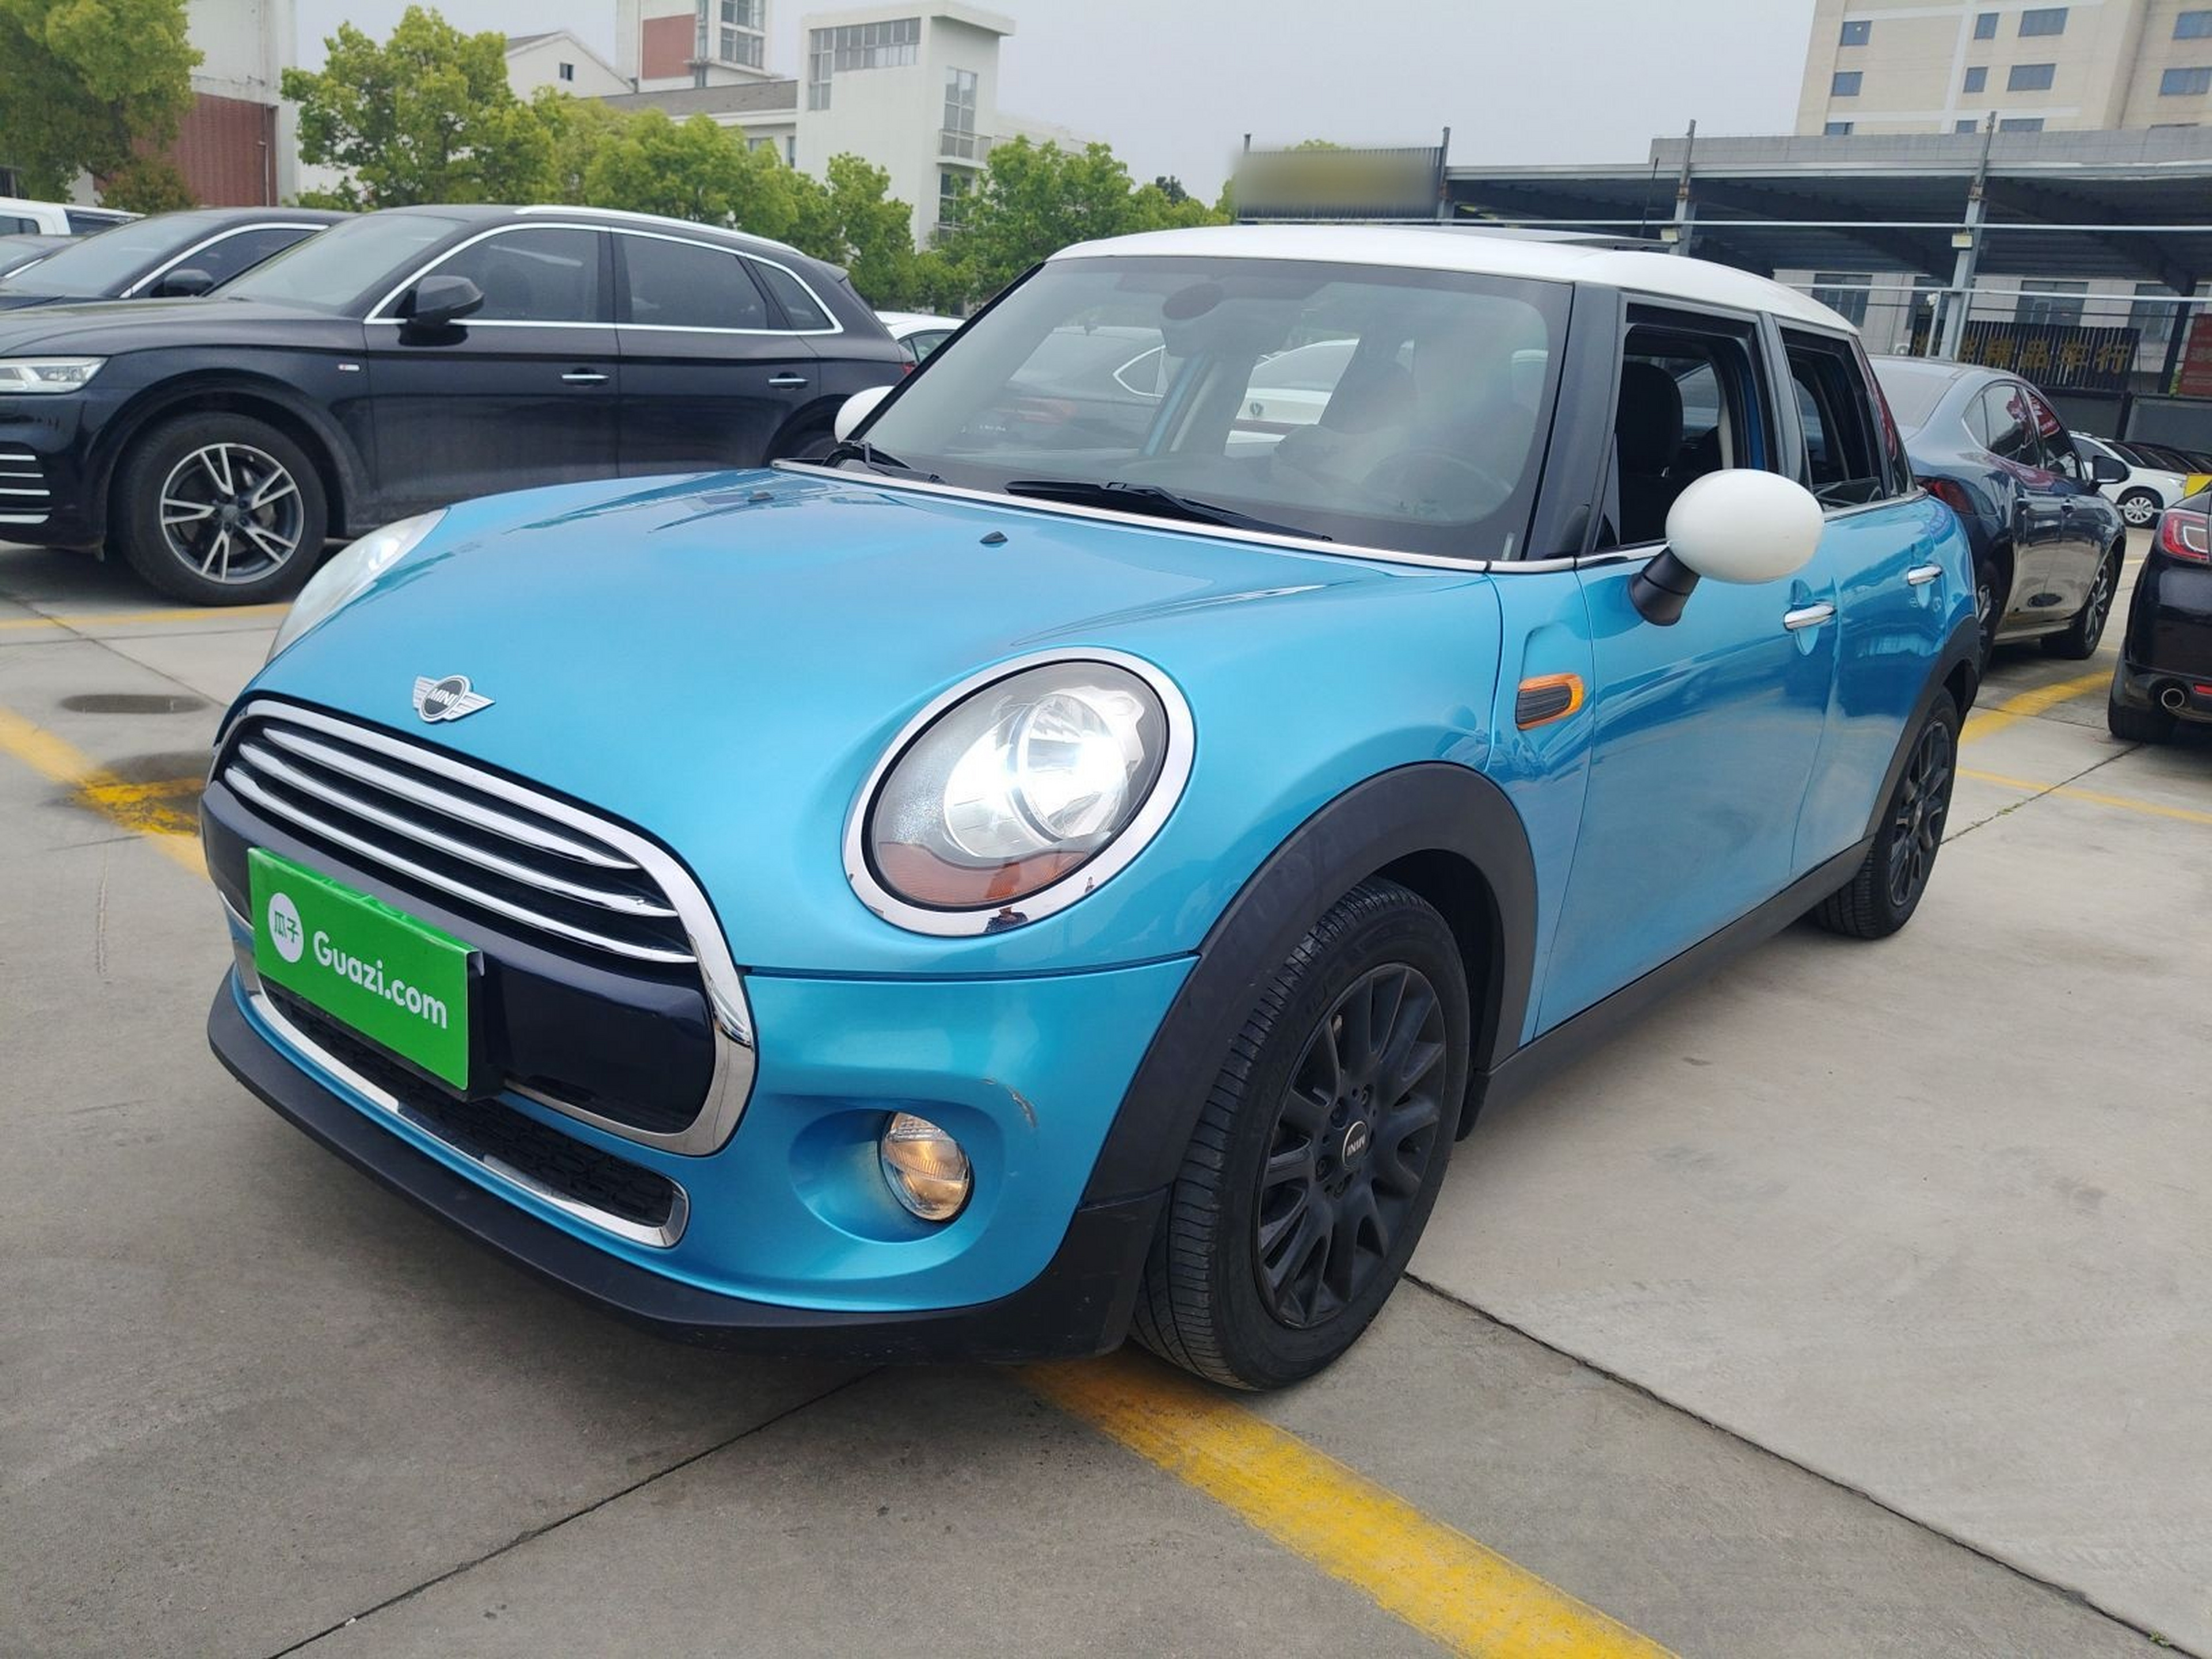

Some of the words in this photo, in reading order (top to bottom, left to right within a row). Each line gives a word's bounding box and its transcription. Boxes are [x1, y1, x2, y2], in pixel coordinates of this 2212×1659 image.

[428, 687, 460, 706] MINI
[274, 910, 300, 944] 瓜子
[313, 930, 448, 1029] Guazi.com
